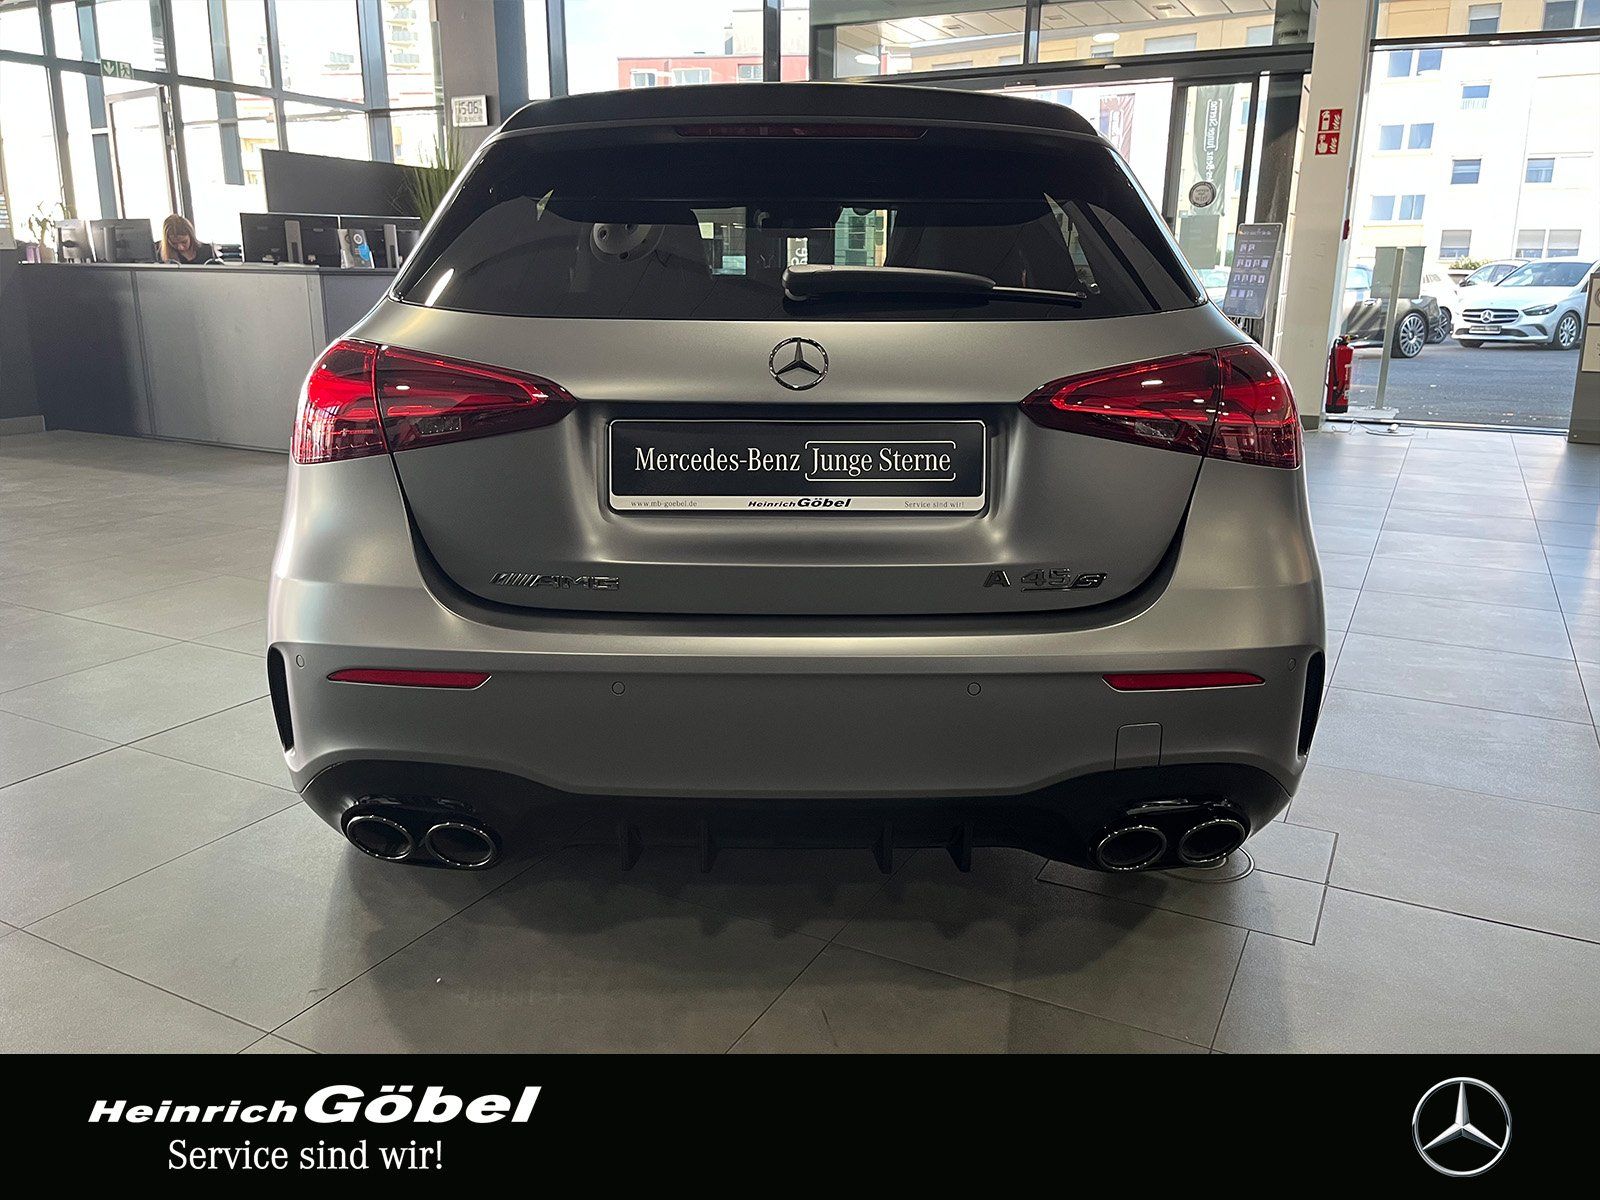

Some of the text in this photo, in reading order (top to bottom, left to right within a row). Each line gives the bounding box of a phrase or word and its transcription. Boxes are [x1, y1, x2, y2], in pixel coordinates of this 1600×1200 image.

[634, 446, 952, 477] Mercedes-Benz Junge Sterne
[797, 498, 852, 507] Göbel
[904, 500, 931, 508] Service
[932, 500, 948, 508] sind
[983, 570, 1012, 588] A
